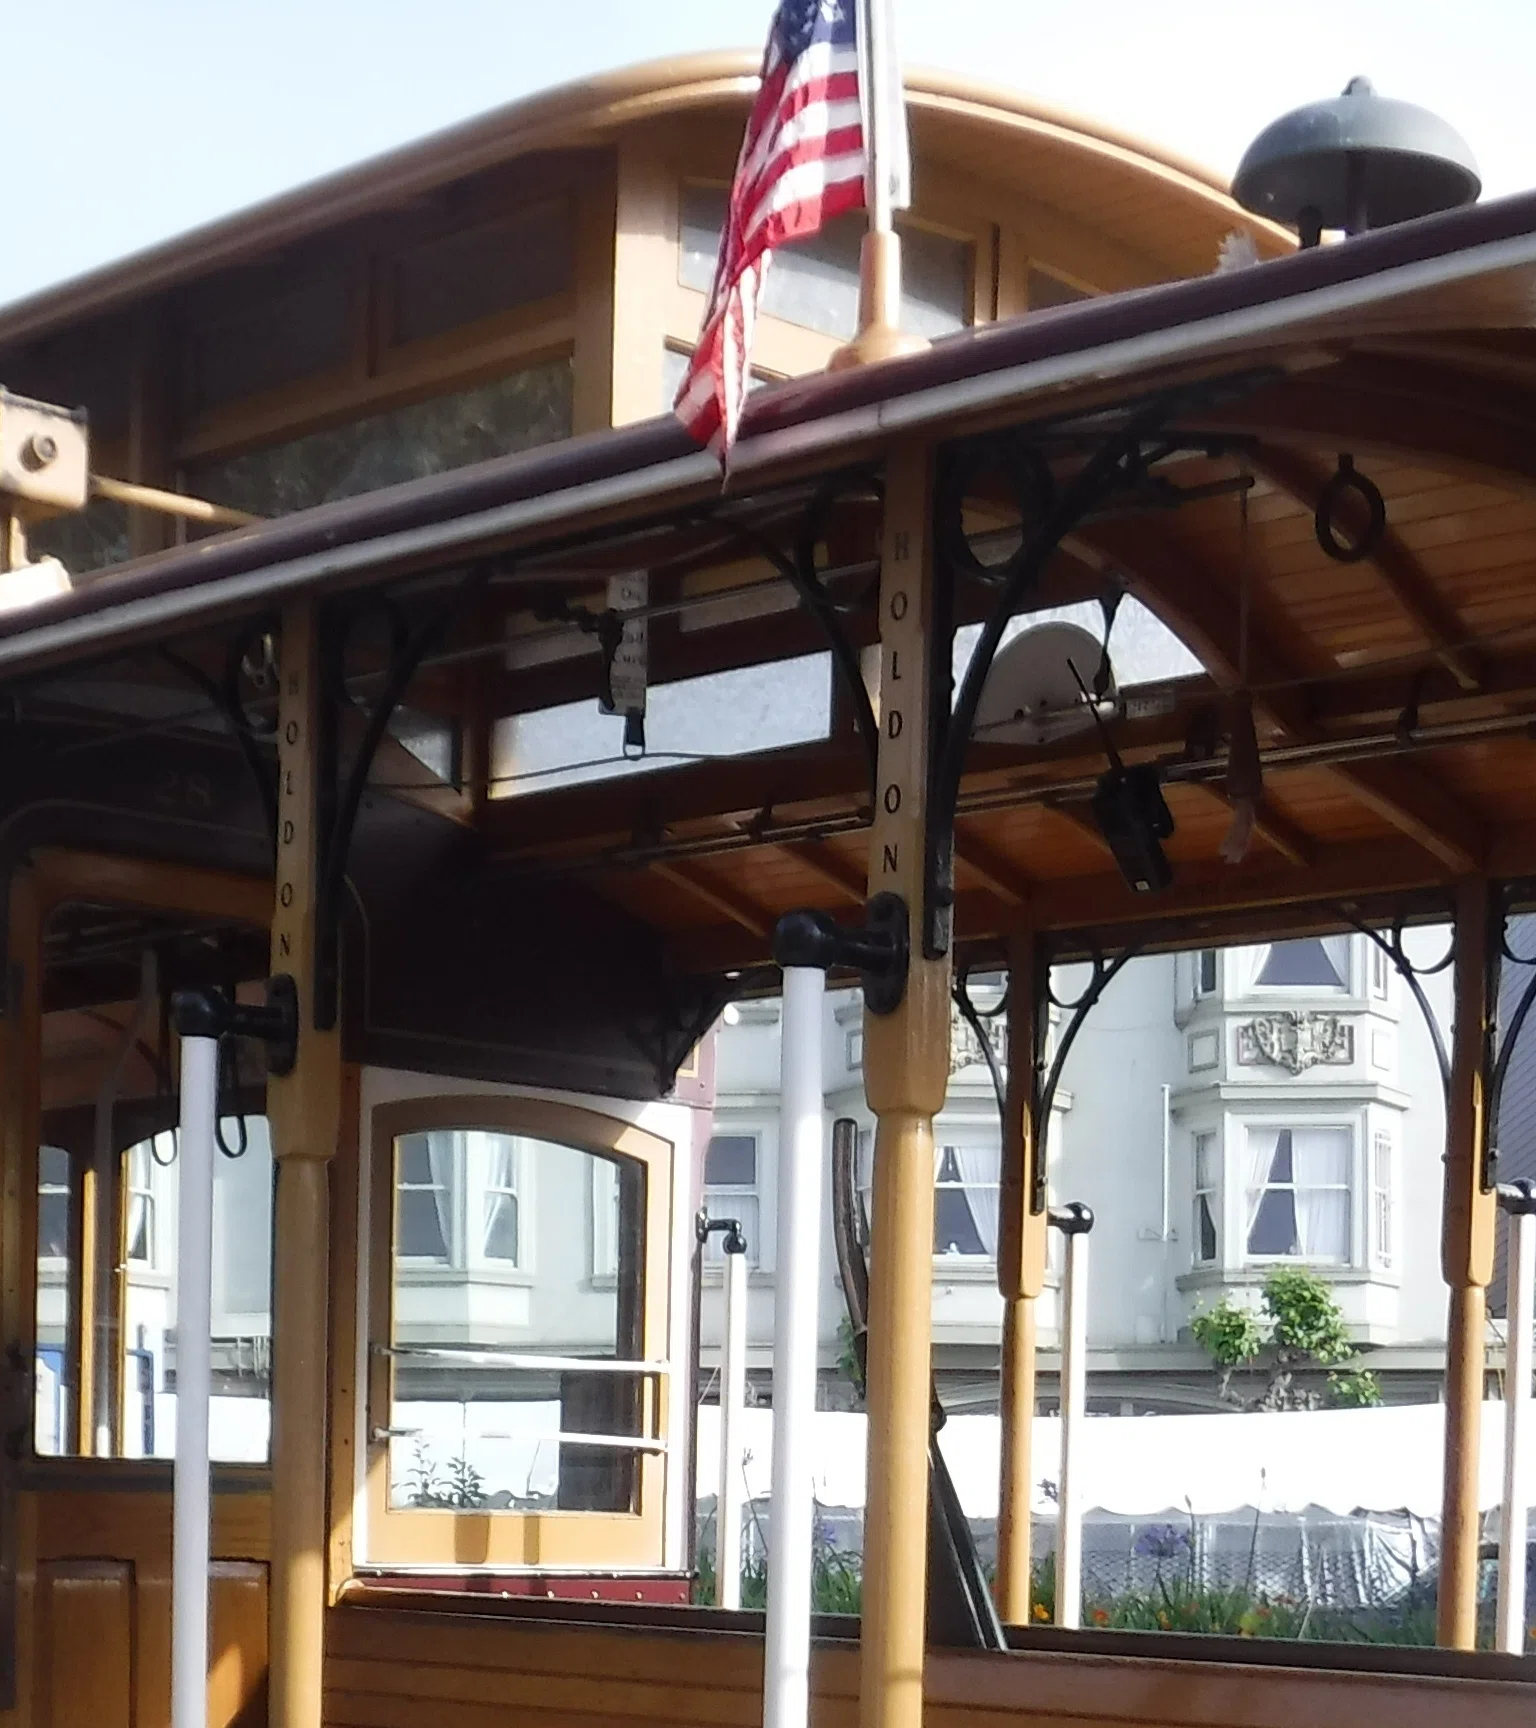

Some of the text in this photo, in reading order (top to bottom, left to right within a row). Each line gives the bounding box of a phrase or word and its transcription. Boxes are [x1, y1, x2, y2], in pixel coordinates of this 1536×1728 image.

[881, 531, 910, 874] HOLD ON
[279, 882, 294, 957] ON
